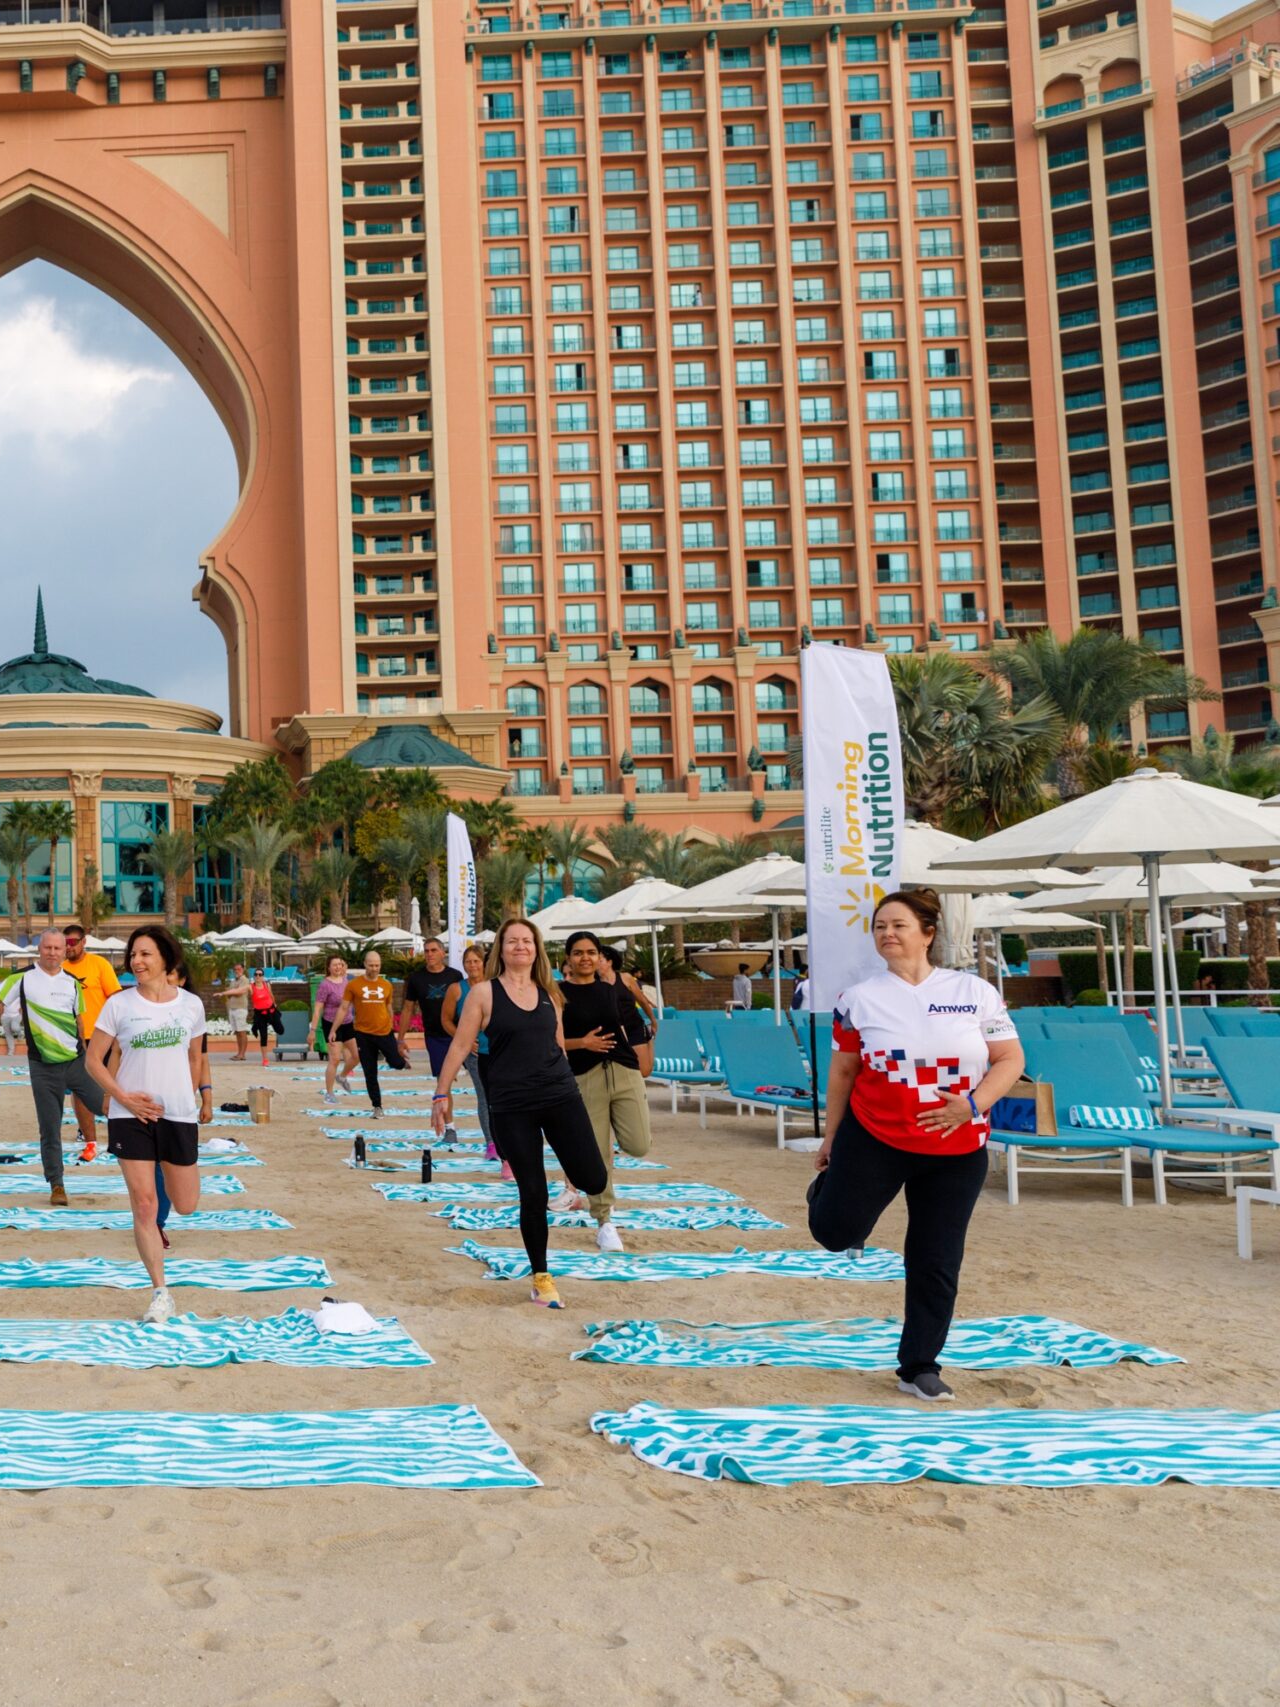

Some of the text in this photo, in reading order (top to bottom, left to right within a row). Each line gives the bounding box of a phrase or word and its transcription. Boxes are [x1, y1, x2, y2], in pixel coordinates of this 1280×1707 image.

[820, 807, 834, 860] nutrilite
[837, 740, 867, 876] Morning
[862, 732, 894, 877] Nutrition
[466, 861, 476, 937] Nutrition
[132, 1027, 187, 1043] HEALTHIER
[928, 1003, 978, 1015] Amway
